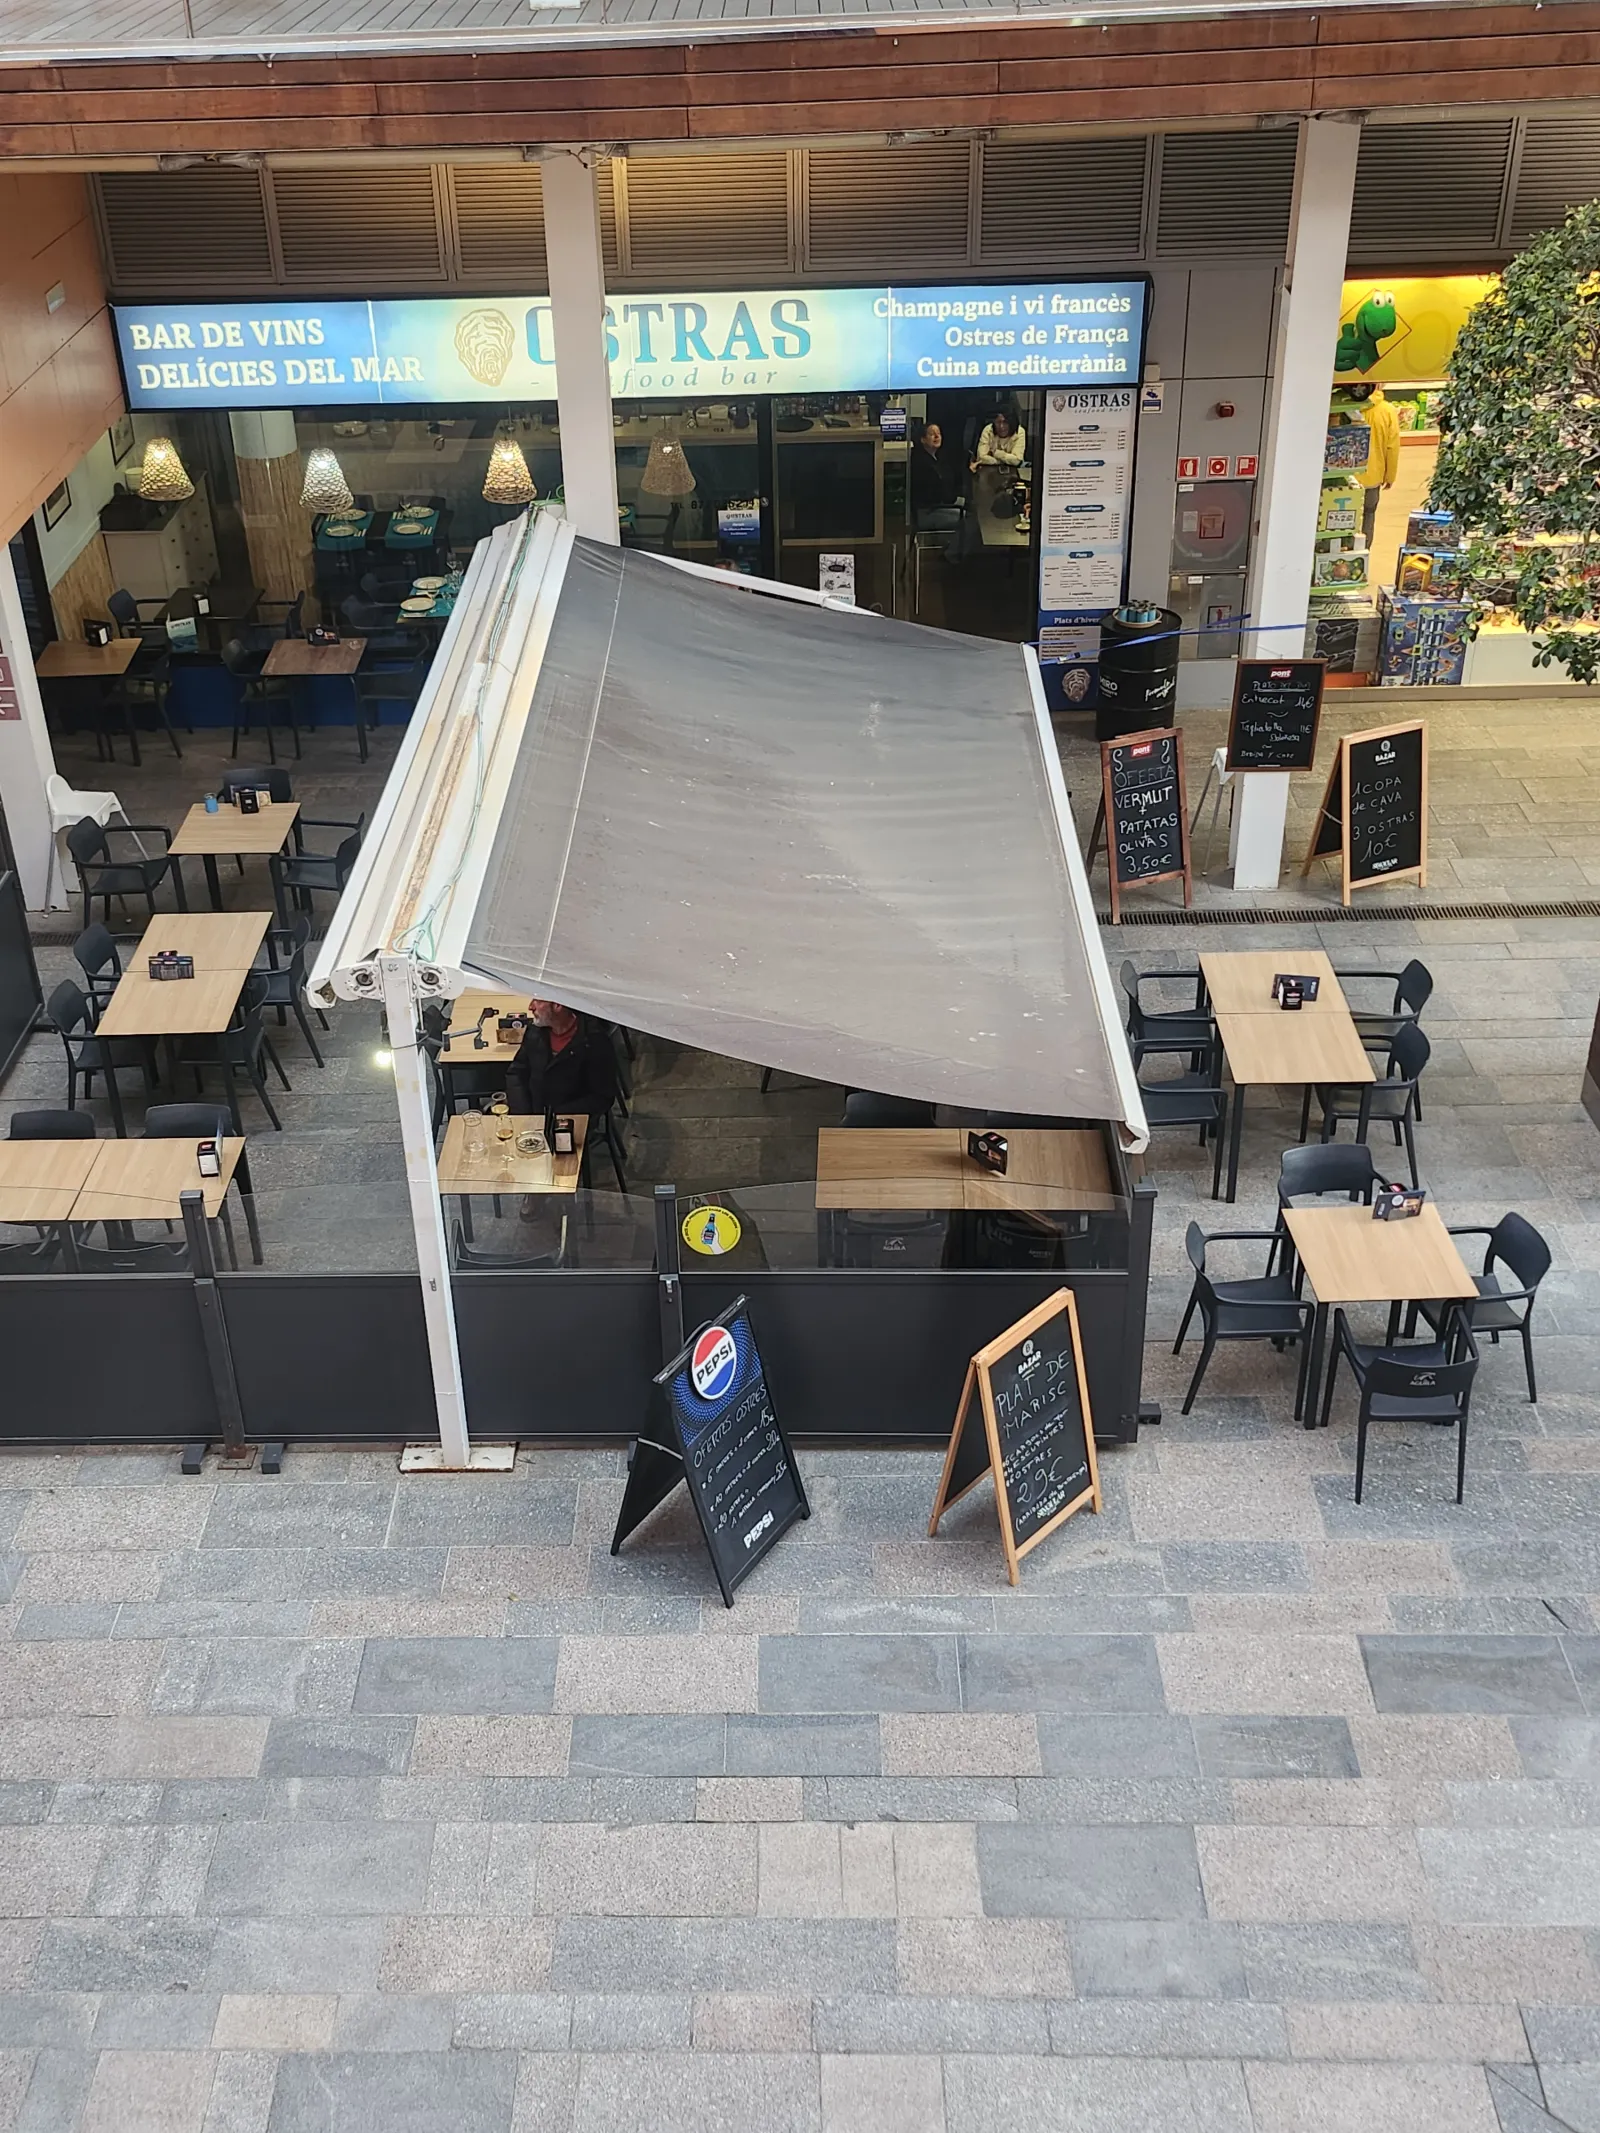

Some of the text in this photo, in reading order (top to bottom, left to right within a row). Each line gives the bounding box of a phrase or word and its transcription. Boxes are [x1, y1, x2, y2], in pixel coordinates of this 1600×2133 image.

[873, 293, 1131, 321] Champagne i vi francès
[130, 318, 324, 351] BAR DE VINS
[945, 324, 1129, 347] Ostres de França
[138, 356, 425, 390] DELÍCIES DEL MAR
[721, 366, 778, 385] bar
[917, 353, 1127, 377] Cuina mediterrània
[1068, 393, 1130, 408] O'STRAS
[1114, 765, 1176, 788] OFERTA
[1114, 785, 1173, 809] VERMUT
[1352, 791, 1402, 815] de CAVA
[1119, 812, 1178, 835] PATATAS
[1353, 810, 1415, 841] 3 OSTRAS
[1119, 833, 1168, 854] OLIVAS
[1359, 832, 1398, 863] 10€
[696, 1340, 733, 1385] PEPSI
[1018, 1351, 1042, 1374] BAZAR
[995, 1373, 1036, 1418] PLAT
[1045, 1350, 1070, 1382] DE
[1003, 1381, 1067, 1439] MARISC
[694, 1383, 767, 1468] OFERTES OSTRES
[743, 1510, 774, 1549] PEPSI
